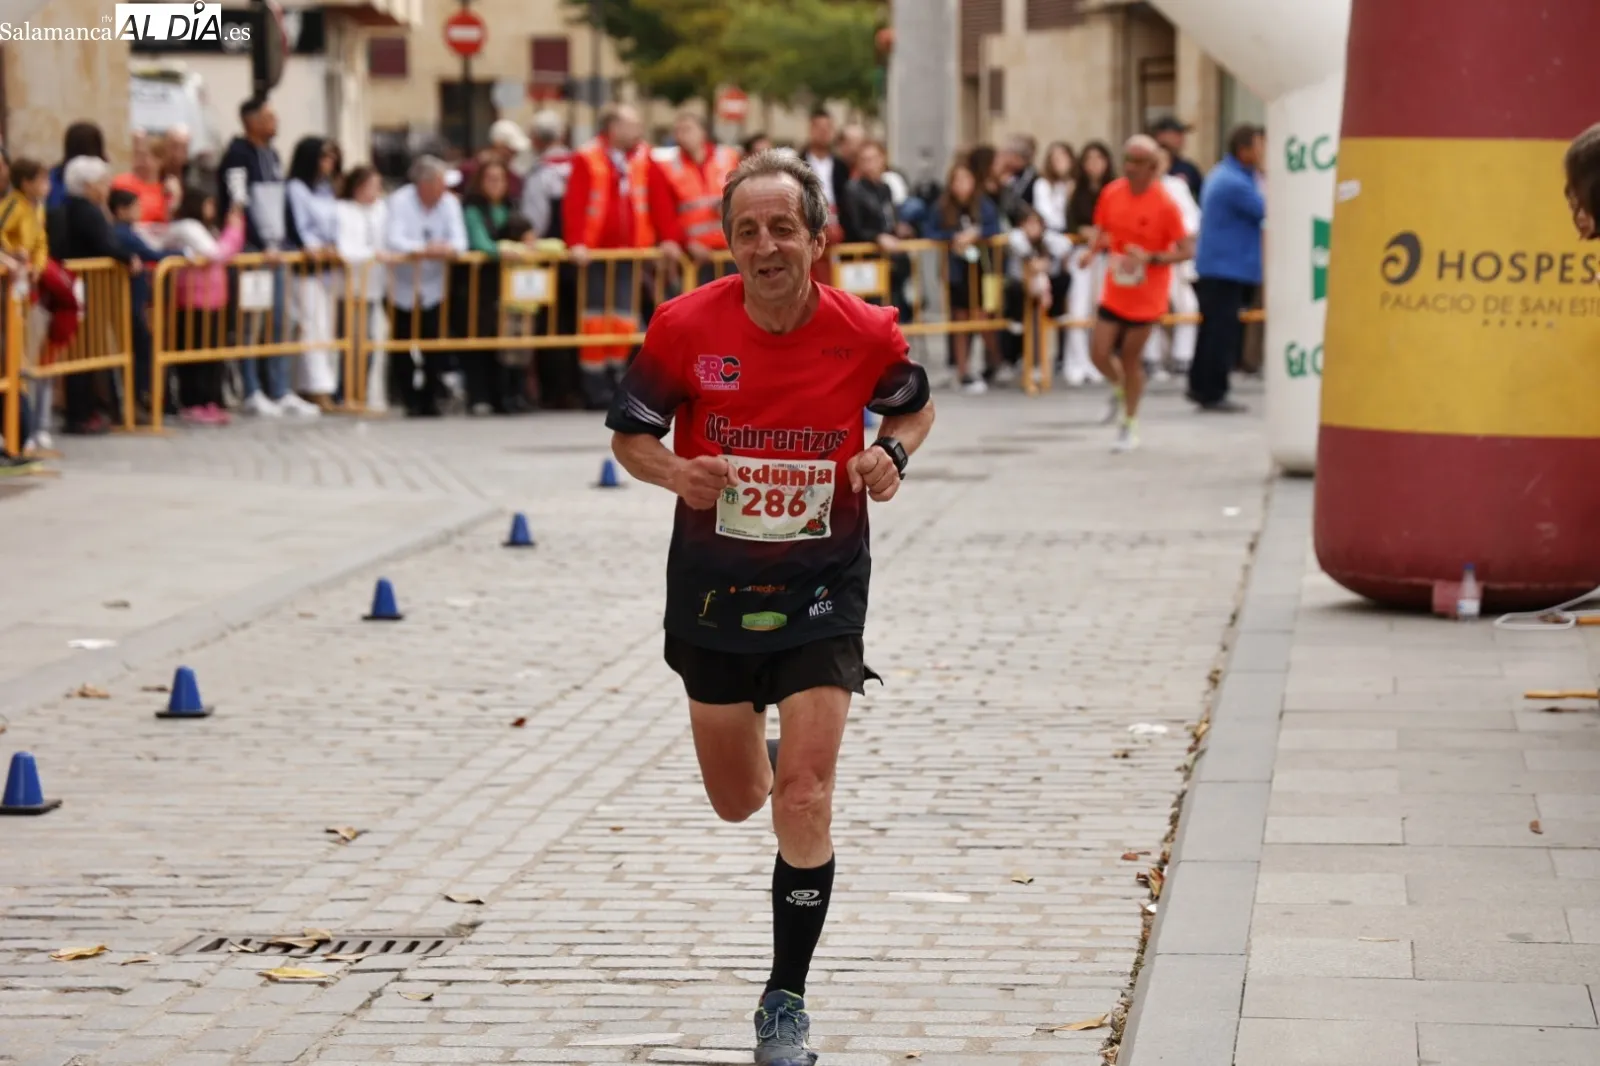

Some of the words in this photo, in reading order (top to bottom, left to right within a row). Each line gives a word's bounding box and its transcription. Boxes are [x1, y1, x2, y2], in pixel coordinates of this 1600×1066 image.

[1436, 250, 1597, 285] HOSPES
[1378, 290, 1477, 313] PALACIO
[1483, 293, 1514, 314] DE
[1519, 295, 1565, 316] SAN
[736, 463, 834, 488] edunia
[741, 487, 808, 518] 286
[808, 600, 834, 618] MSC
[795, 899, 823, 907] SPORT
